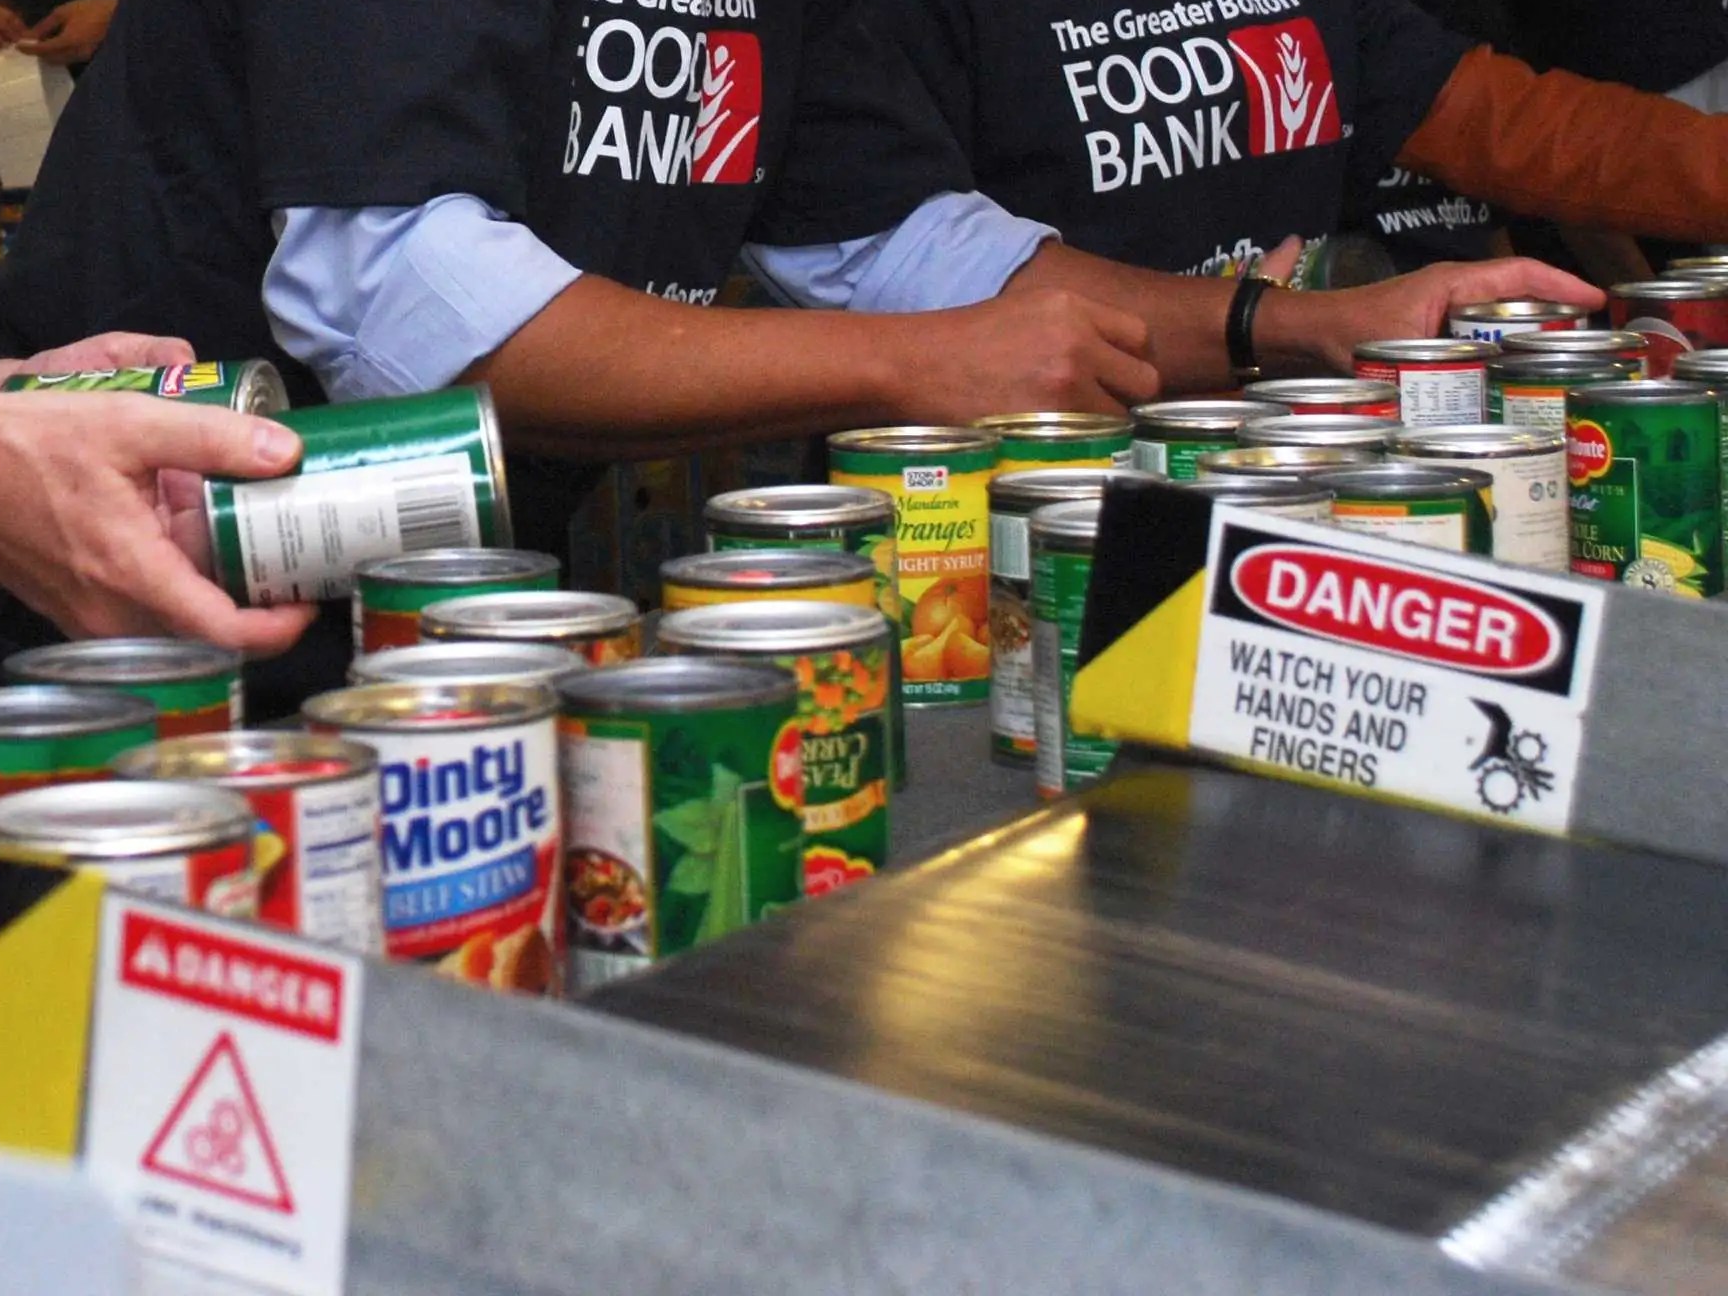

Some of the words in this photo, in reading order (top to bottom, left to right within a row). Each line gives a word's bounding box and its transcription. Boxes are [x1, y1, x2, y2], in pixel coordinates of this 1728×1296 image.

[1051, 19, 1110, 53] The
[1062, 36, 1235, 123] FOOD
[562, 101, 694, 186] BANK
[1084, 100, 1243, 194] BANK
[898, 556, 940, 572] IGHT
[943, 552, 985, 571] SYRUP
[1583, 540, 1625, 562] CORN
[1265, 558, 1518, 661] DANGER
[1229, 640, 1339, 695] WATCH
[1345, 667, 1428, 716] YOUR
[1234, 682, 1337, 736] HANDS
[1344, 711, 1408, 753] AND
[380, 739, 525, 816] Dinty
[1249, 727, 1379, 787] FINGERS
[381, 784, 547, 874] Moore
[176, 945, 336, 1024] DANGER
